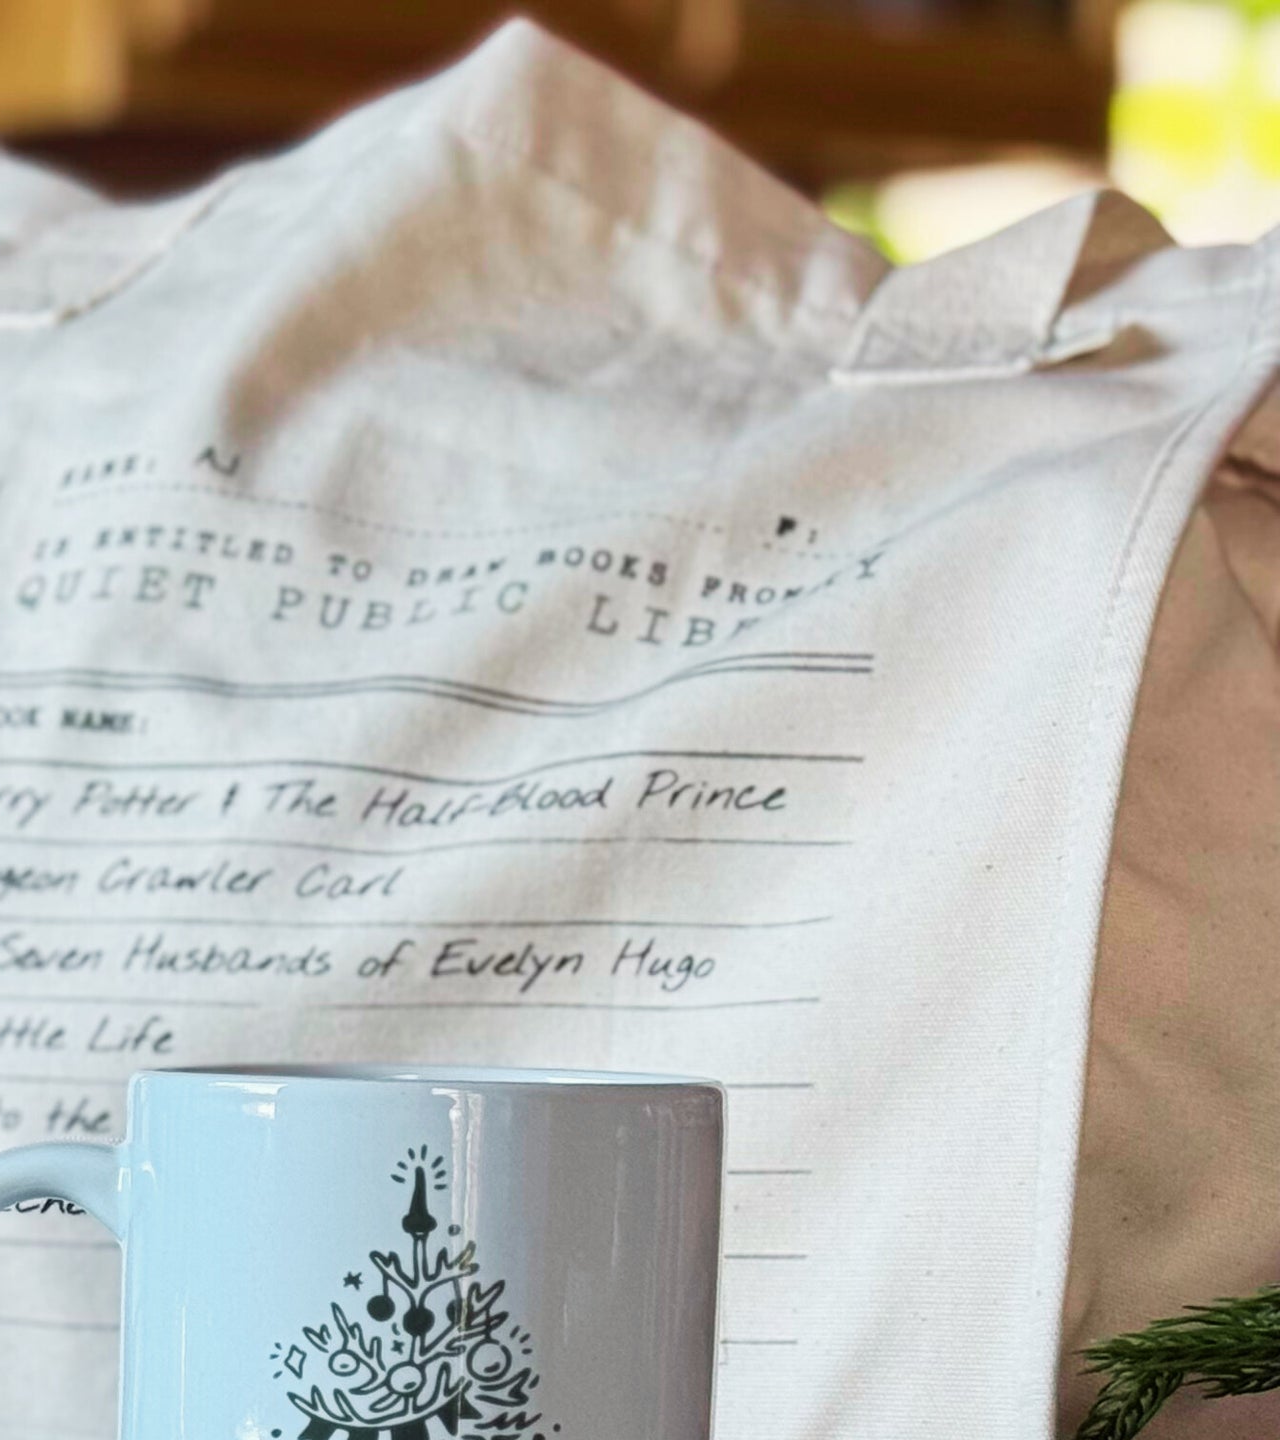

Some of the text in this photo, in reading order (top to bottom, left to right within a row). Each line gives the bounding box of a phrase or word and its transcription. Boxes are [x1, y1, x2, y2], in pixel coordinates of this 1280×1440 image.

[94, 526, 294, 565] ENTITLED
[328, 553, 372, 582] TO
[536, 547, 669, 586] BOOKS
[16, 564, 217, 612] QUIET
[270, 581, 530, 631] PUBLIC
[61, 708, 147, 735] NAME:
[73, 779, 201, 820] Potter
[263, 777, 337, 820] The
[636, 769, 788, 813] Prince
[97, 847, 271, 895] Crawler
[295, 863, 406, 899] Carl
[123, 932, 333, 977] Husbands
[357, 938, 420, 980] of
[430, 936, 585, 994] Evelyn
[610, 936, 716, 994] Hugo
[87, 1013, 178, 1057] Life
[46, 1095, 112, 1134] the
